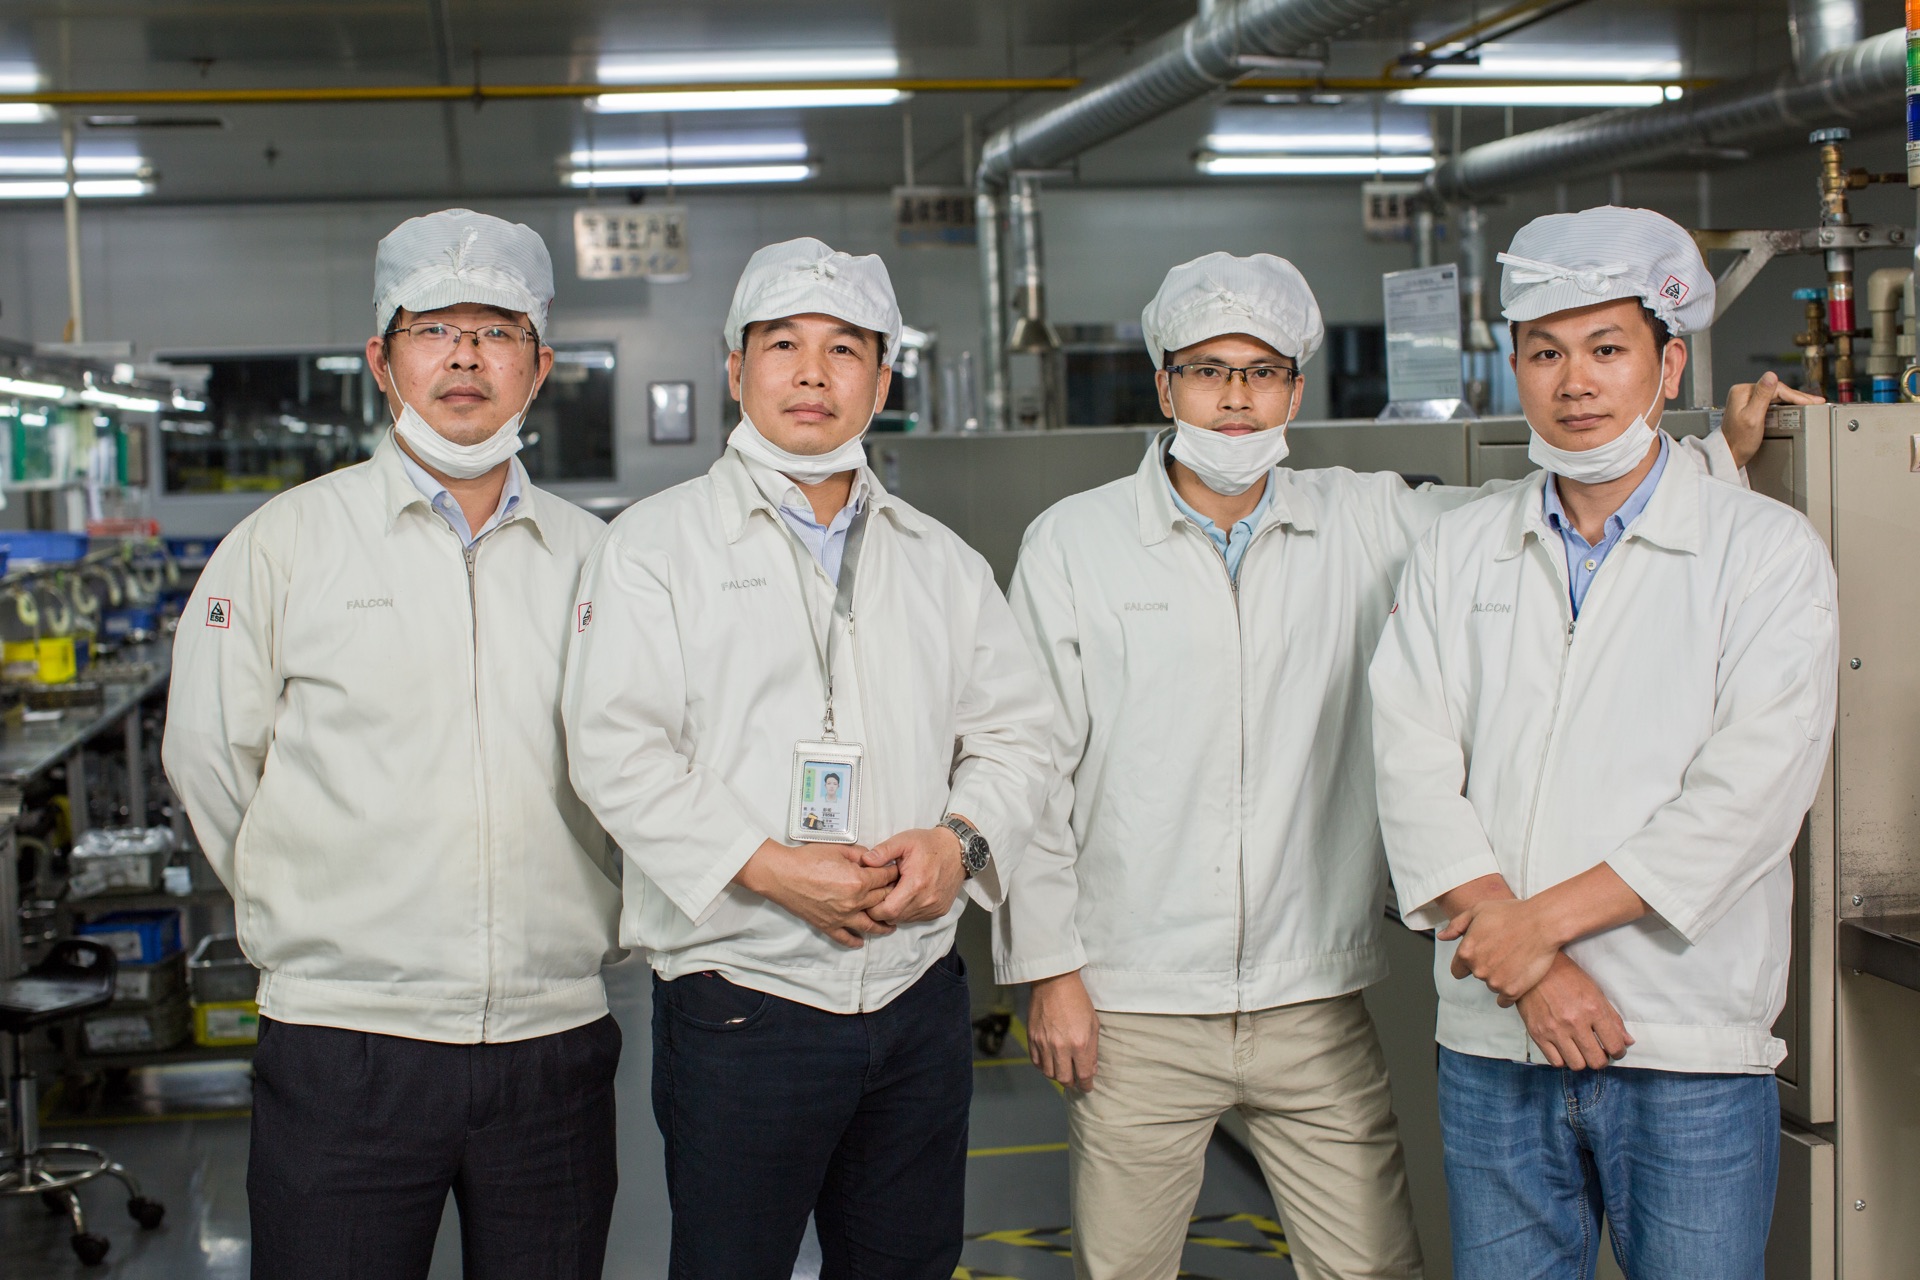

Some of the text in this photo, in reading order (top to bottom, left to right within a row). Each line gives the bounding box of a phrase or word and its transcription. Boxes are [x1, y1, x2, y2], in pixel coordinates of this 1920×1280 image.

[1665, 287, 1679, 300] ESD
[720, 577, 767, 592] FALCON
[346, 598, 393, 610] FALCON
[1123, 602, 1169, 611] FALCON
[1471, 602, 1511, 613] ALCON
[210, 614, 225, 623] ESD
